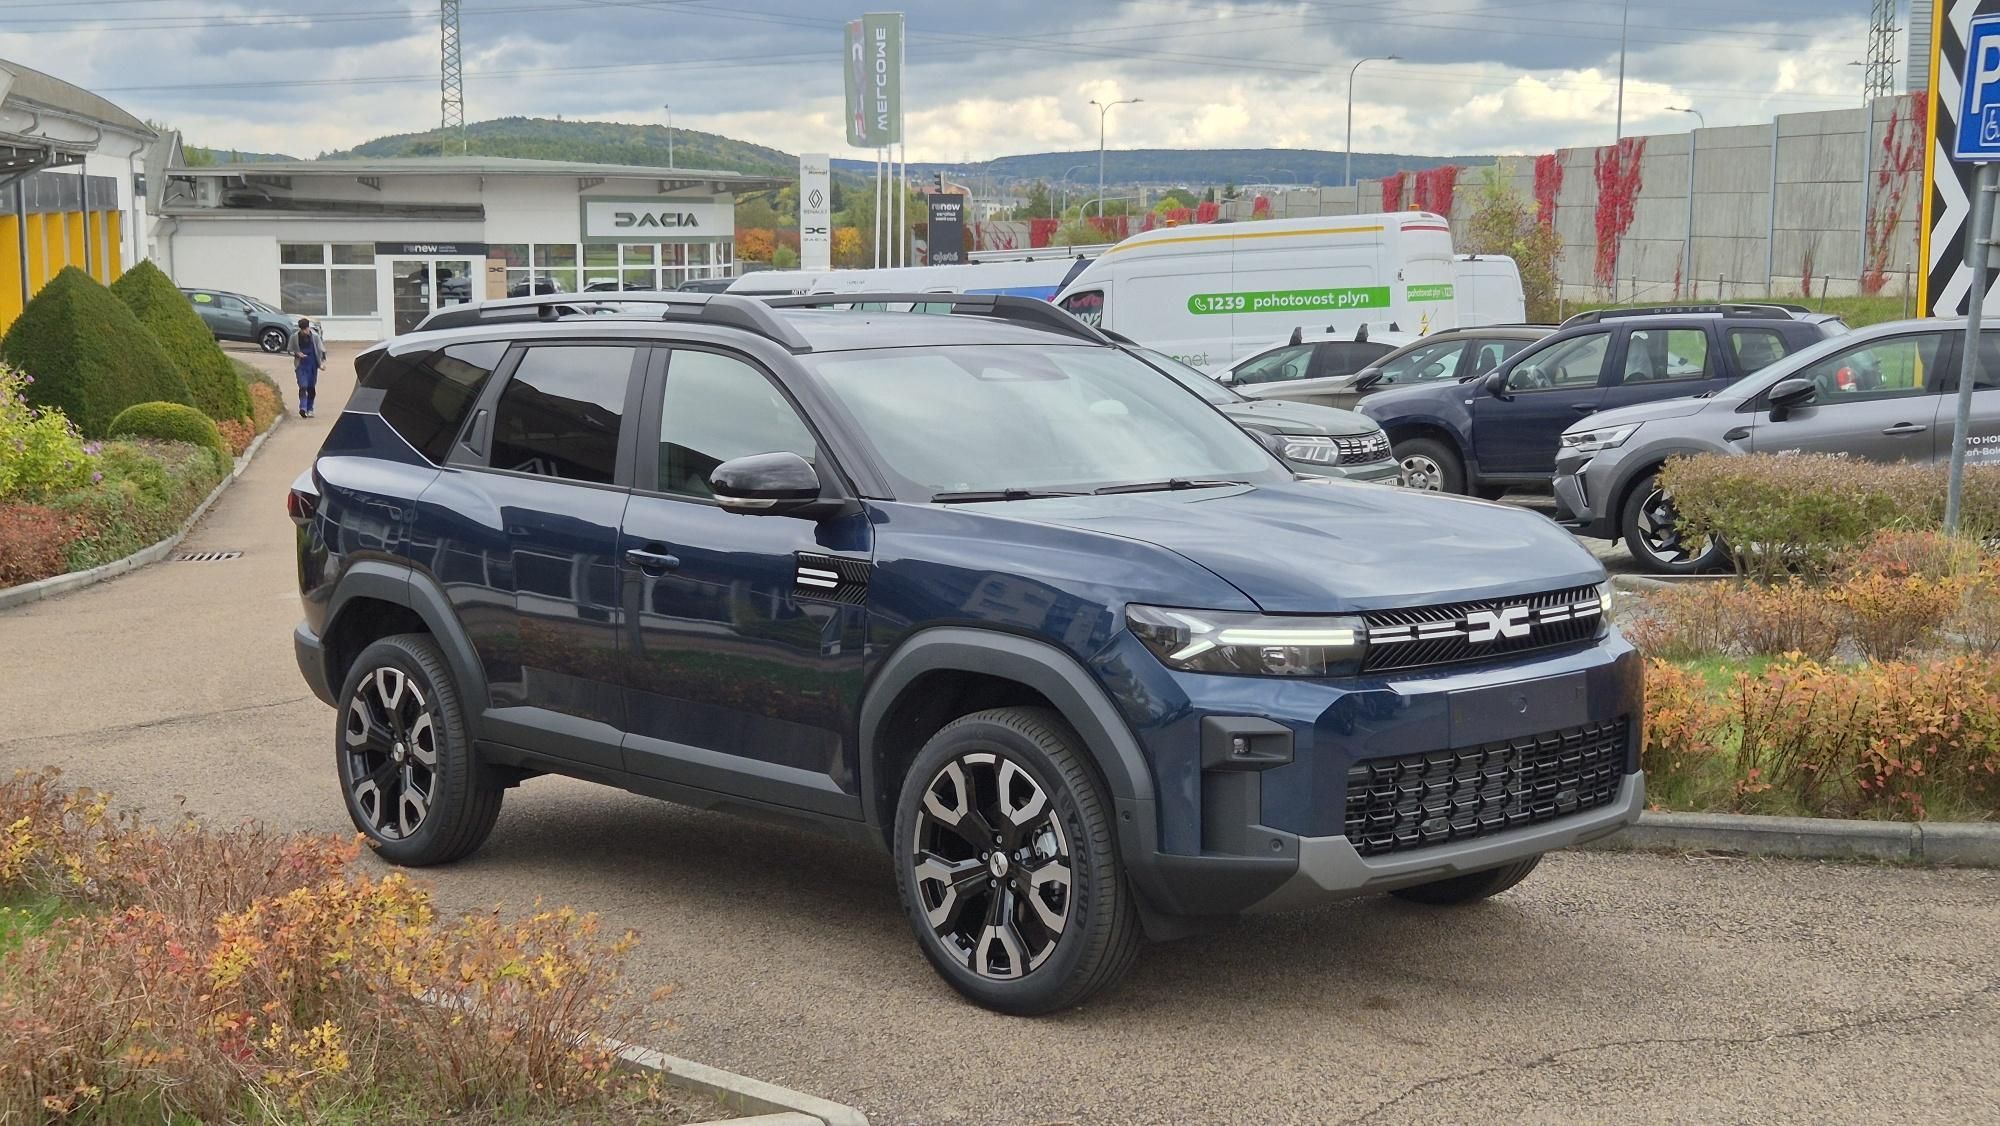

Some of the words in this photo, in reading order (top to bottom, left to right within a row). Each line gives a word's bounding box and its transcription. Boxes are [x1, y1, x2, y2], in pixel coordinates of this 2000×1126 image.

[1970, 34, 2000, 115] P
[615, 212, 699, 227] DACIA
[1207, 296, 1245, 310] 1239
[1253, 292, 1334, 310] pohotovost
[1338, 291, 1369, 307] plyn
[1982, 435, 2000, 443] HO
